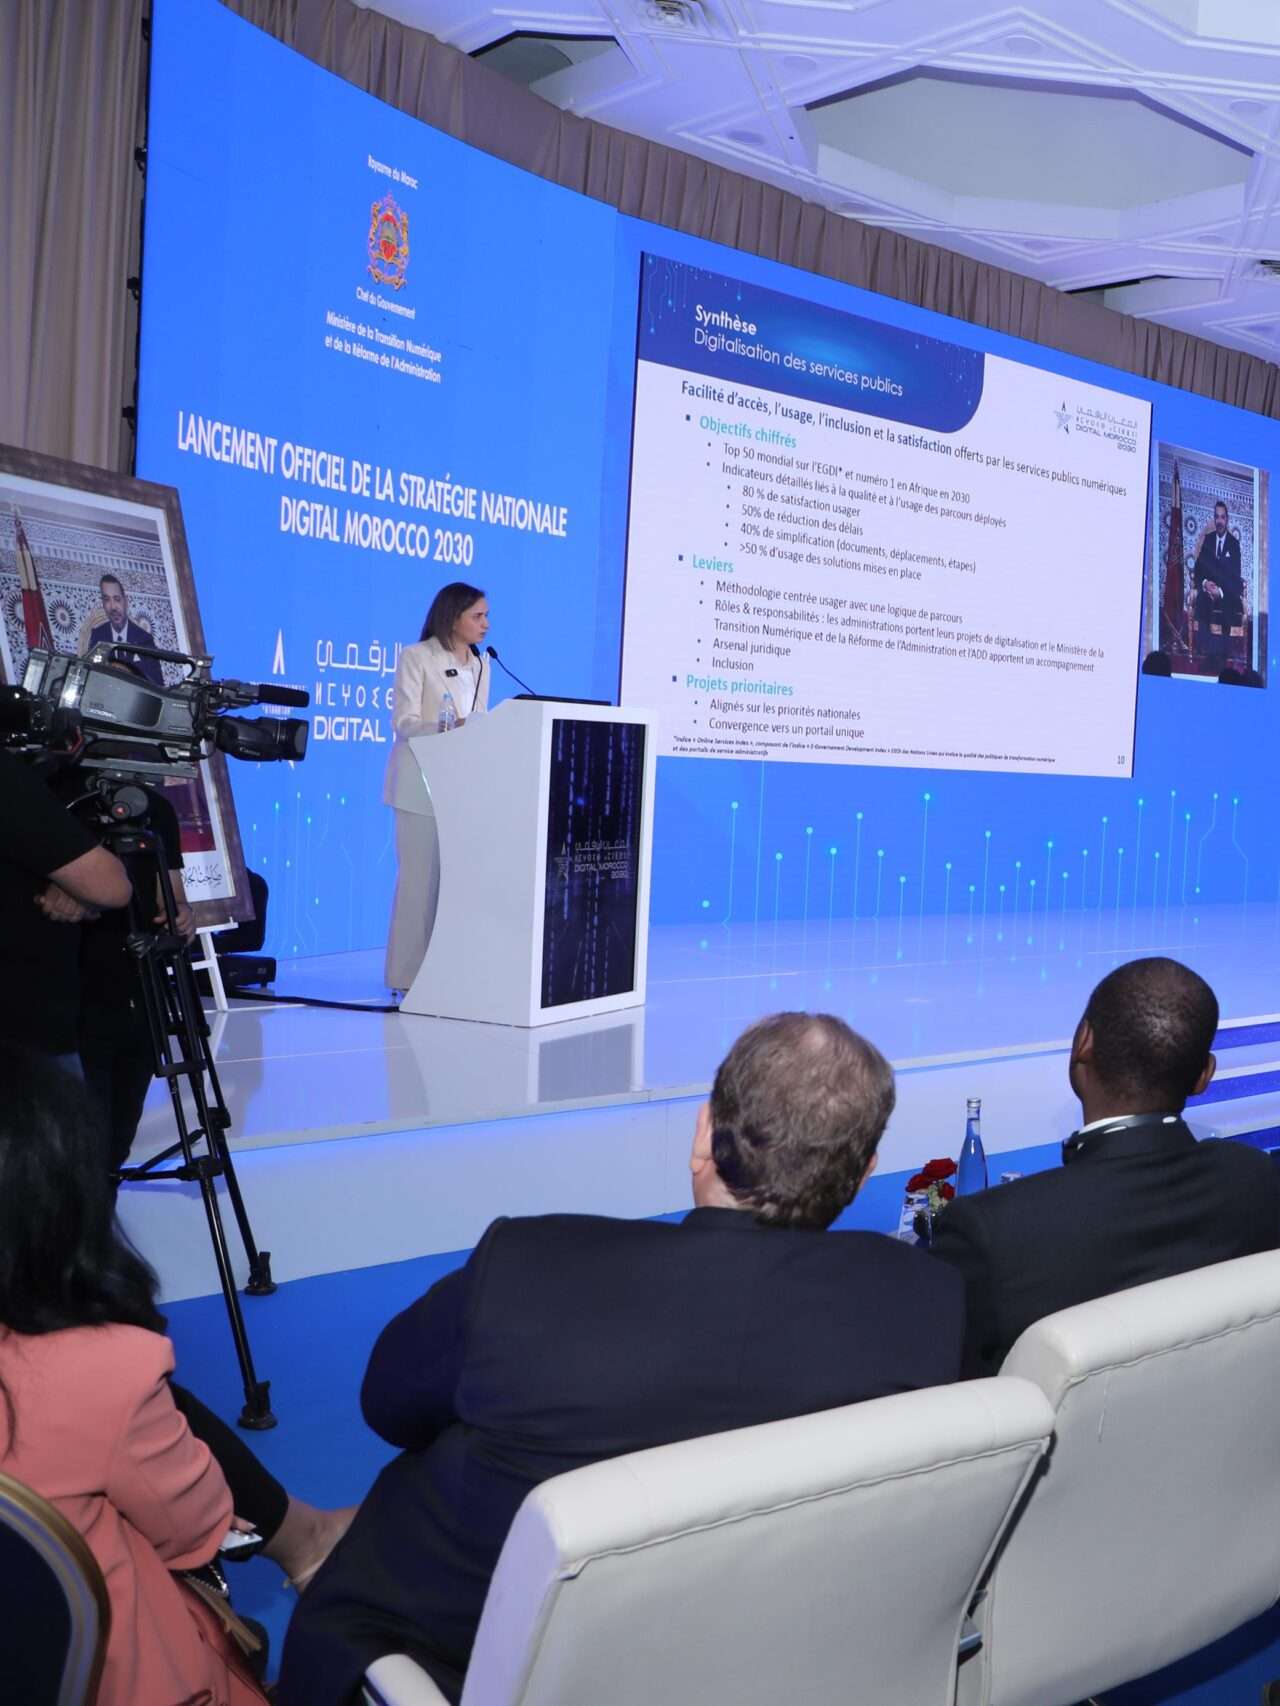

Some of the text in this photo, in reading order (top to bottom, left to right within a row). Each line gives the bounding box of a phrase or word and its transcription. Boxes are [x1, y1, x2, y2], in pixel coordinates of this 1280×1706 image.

[326, 310, 442, 363] Ministère de la Transition Numérique
[695, 304, 757, 336] Synthèse
[325, 336, 441, 383] et de la Réforme de l'Administration
[694, 327, 903, 397] Digitalisation des services publics
[681, 380, 1127, 497] Facilité d'accès, l'usage, l'inclusion satisfaction offerts par les services publics numériques
[700, 416, 797, 449] Objectifs chiffrés
[177, 411, 568, 538] LANCEMENT OFFICIEL DE LA STRATÉGIE NATIONALE
[724, 442, 741, 459] Top
[743, 446, 755, 460] 50
[757, 452, 794, 468] mondial
[795, 460, 810, 471] sur
[856, 473, 889, 487] numéro
[908, 482, 938, 498] Afrique
[951, 490, 970, 504] 2030
[722, 462, 1007, 528] Indicateurs détaillés liés qualité l'usage des parcours déployés
[742, 485, 861, 518] 80 de satisfaction usager
[280, 496, 474, 567] DIGITAL MOROCCO 2030
[742, 504, 864, 536] 50% de réduction des délais
[693, 554, 734, 573] Leviers
[740, 522, 976, 574] 40% de simplification (documents, déplacements, étapes)
[740, 542, 922, 581] >50 d'usage des solutions mises place
[716, 580, 963, 624] Méthodologie centrée usager avec une logique de parcours
[713, 637, 791, 658] Arsenal juridique
[714, 618, 1095, 673] Transition Numérique Réforme l'Administration l'ADD apportent accompagnement
[715, 599, 1088, 657] Rôles responsabilités les administrations portent leurs projets digitalisation Ministère
[712, 656, 754, 672] Inclusion
[686, 674, 794, 696] Projets prioritaires
[314, 716, 386, 742] DIGITAL
[709, 717, 865, 740] Convergence vers portail unique
[710, 698, 861, 721] Alignés sur les priorités nationales
[1117, 755, 1125, 765] 10
